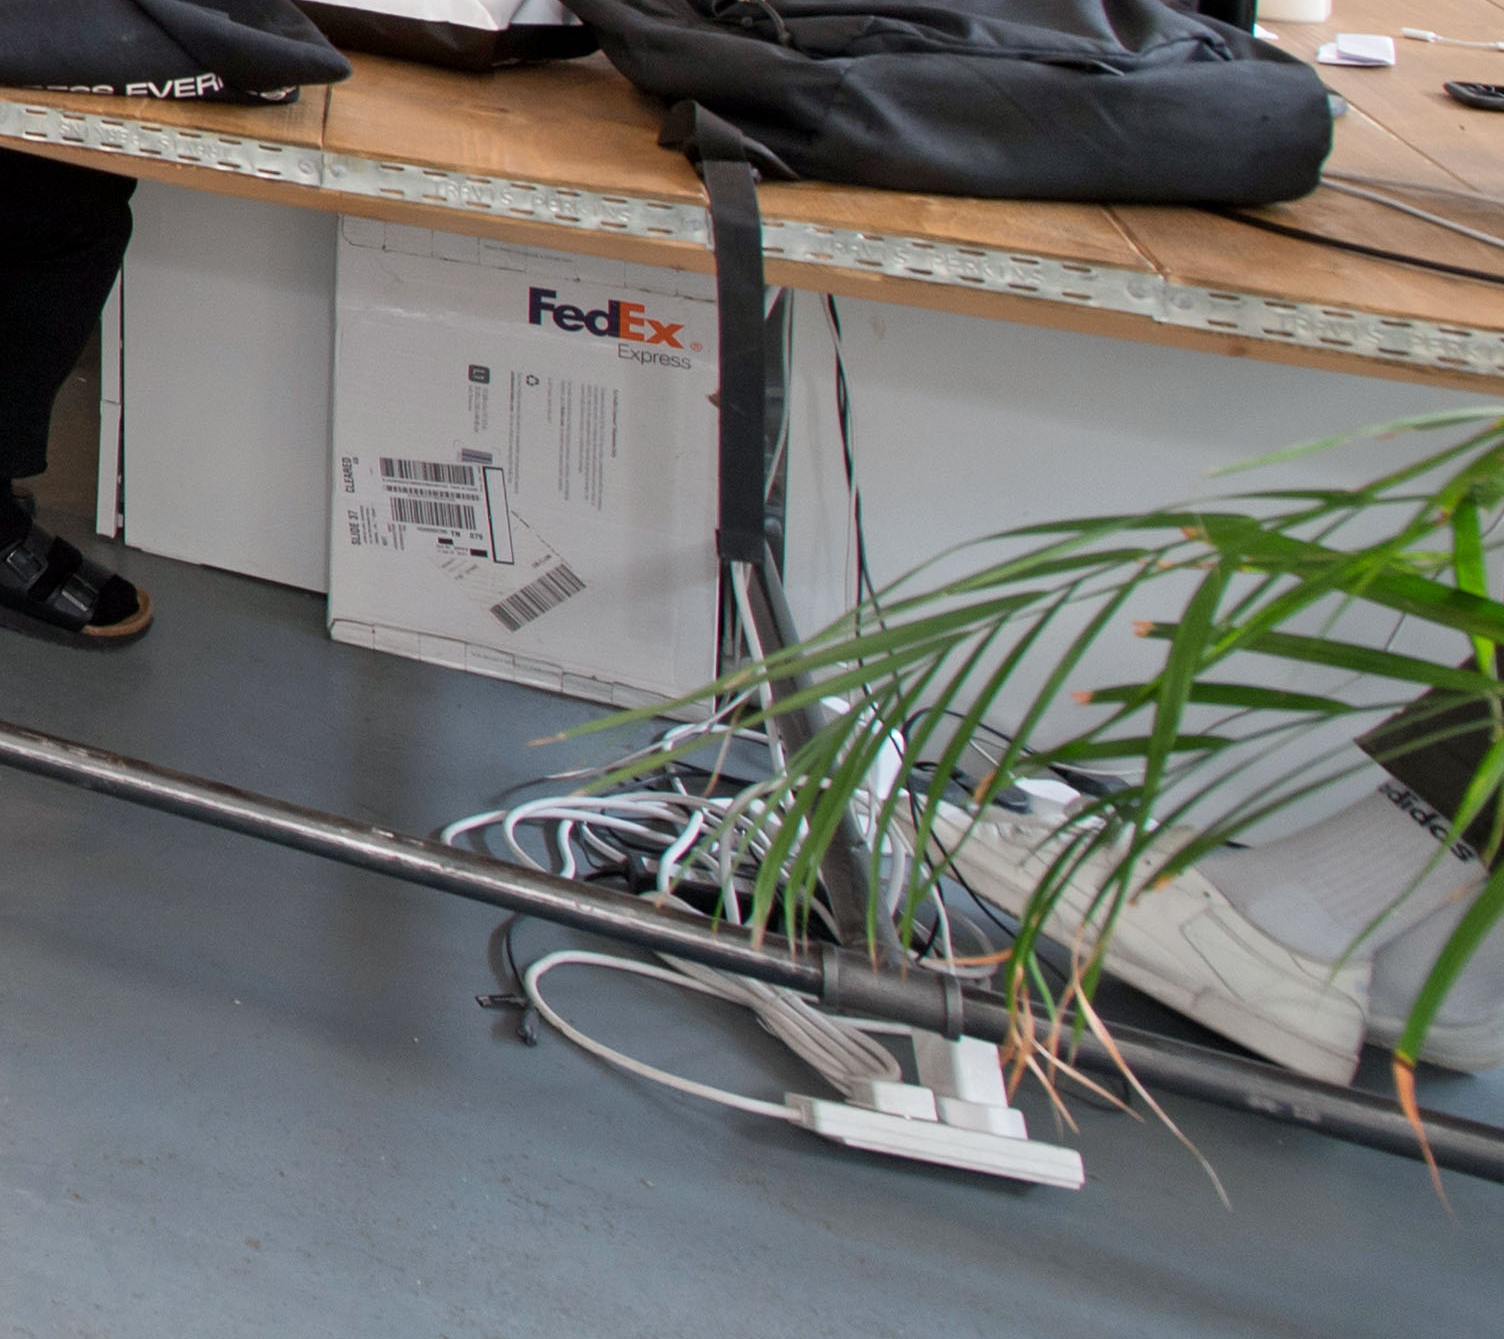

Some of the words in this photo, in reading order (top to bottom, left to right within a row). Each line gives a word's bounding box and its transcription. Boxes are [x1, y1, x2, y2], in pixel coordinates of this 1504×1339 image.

[528, 286, 685, 350] FedEx
[617, 343, 692, 370] Express
[341, 457, 356, 494] CLEARED
[347, 522, 362, 546] SLIDE
